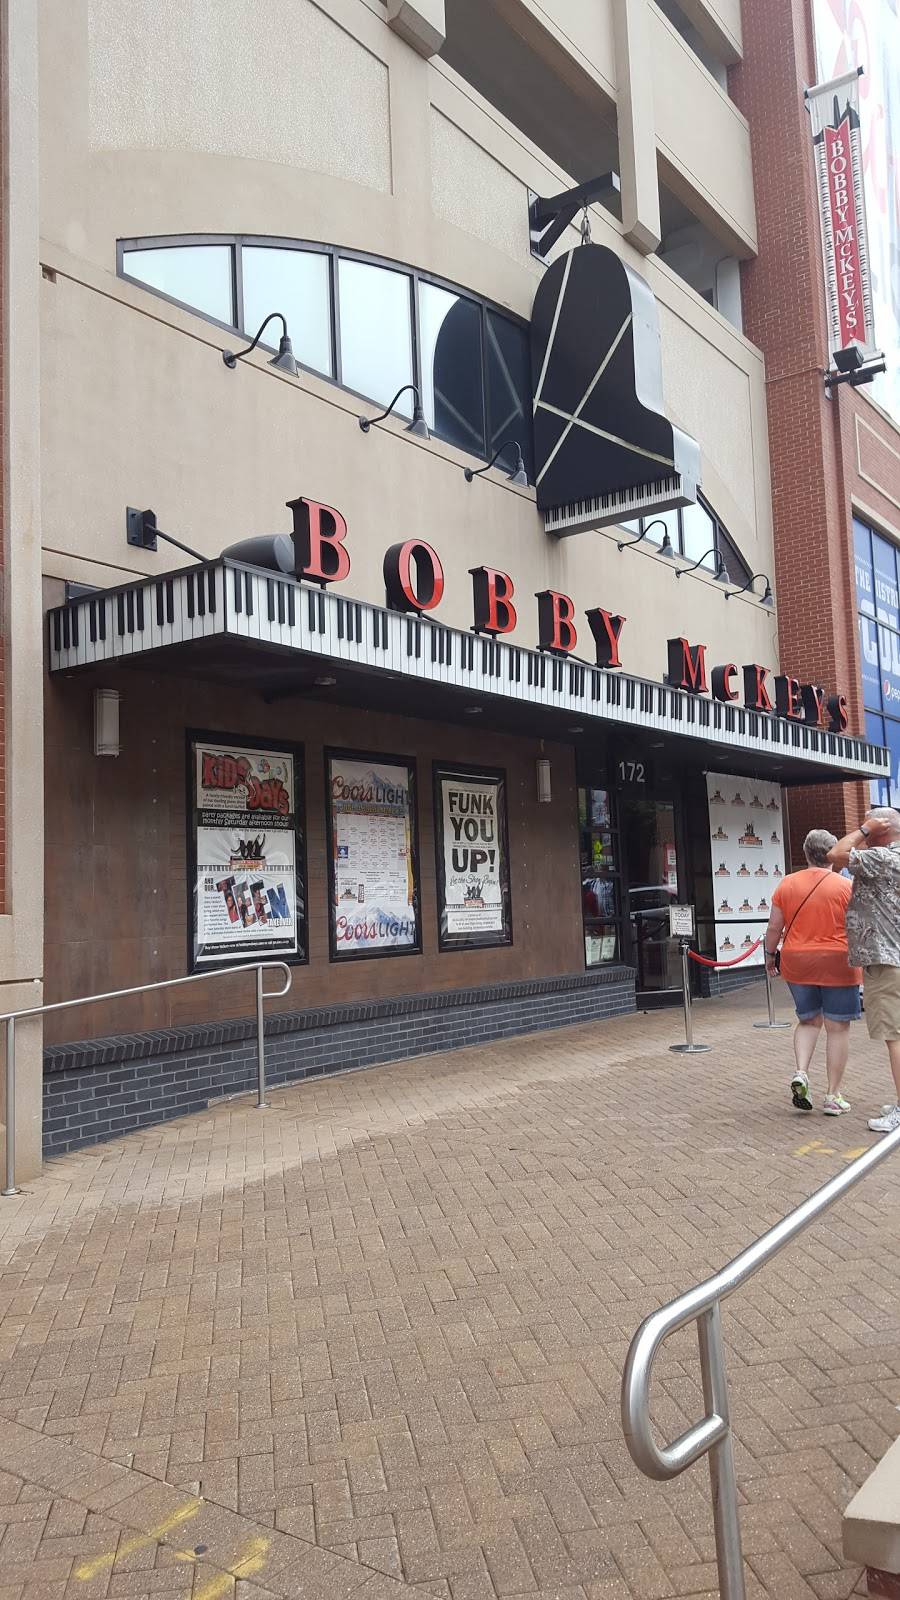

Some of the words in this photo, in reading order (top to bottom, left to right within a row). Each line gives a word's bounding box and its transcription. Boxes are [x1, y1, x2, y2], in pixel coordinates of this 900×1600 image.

[831, 138, 848, 223] BOBBY
[286, 496, 626, 668] BOBBY
[619, 761, 646, 783] 172
[332, 776, 373, 801] Coors
[449, 791, 494, 815] FUNK
[450, 817, 494, 842] YOU
[452, 849, 495, 872] UP!
[216, 875, 291, 929] TEEN
[336, 915, 377, 941] Coors
[379, 920, 415, 938] LIGHT
